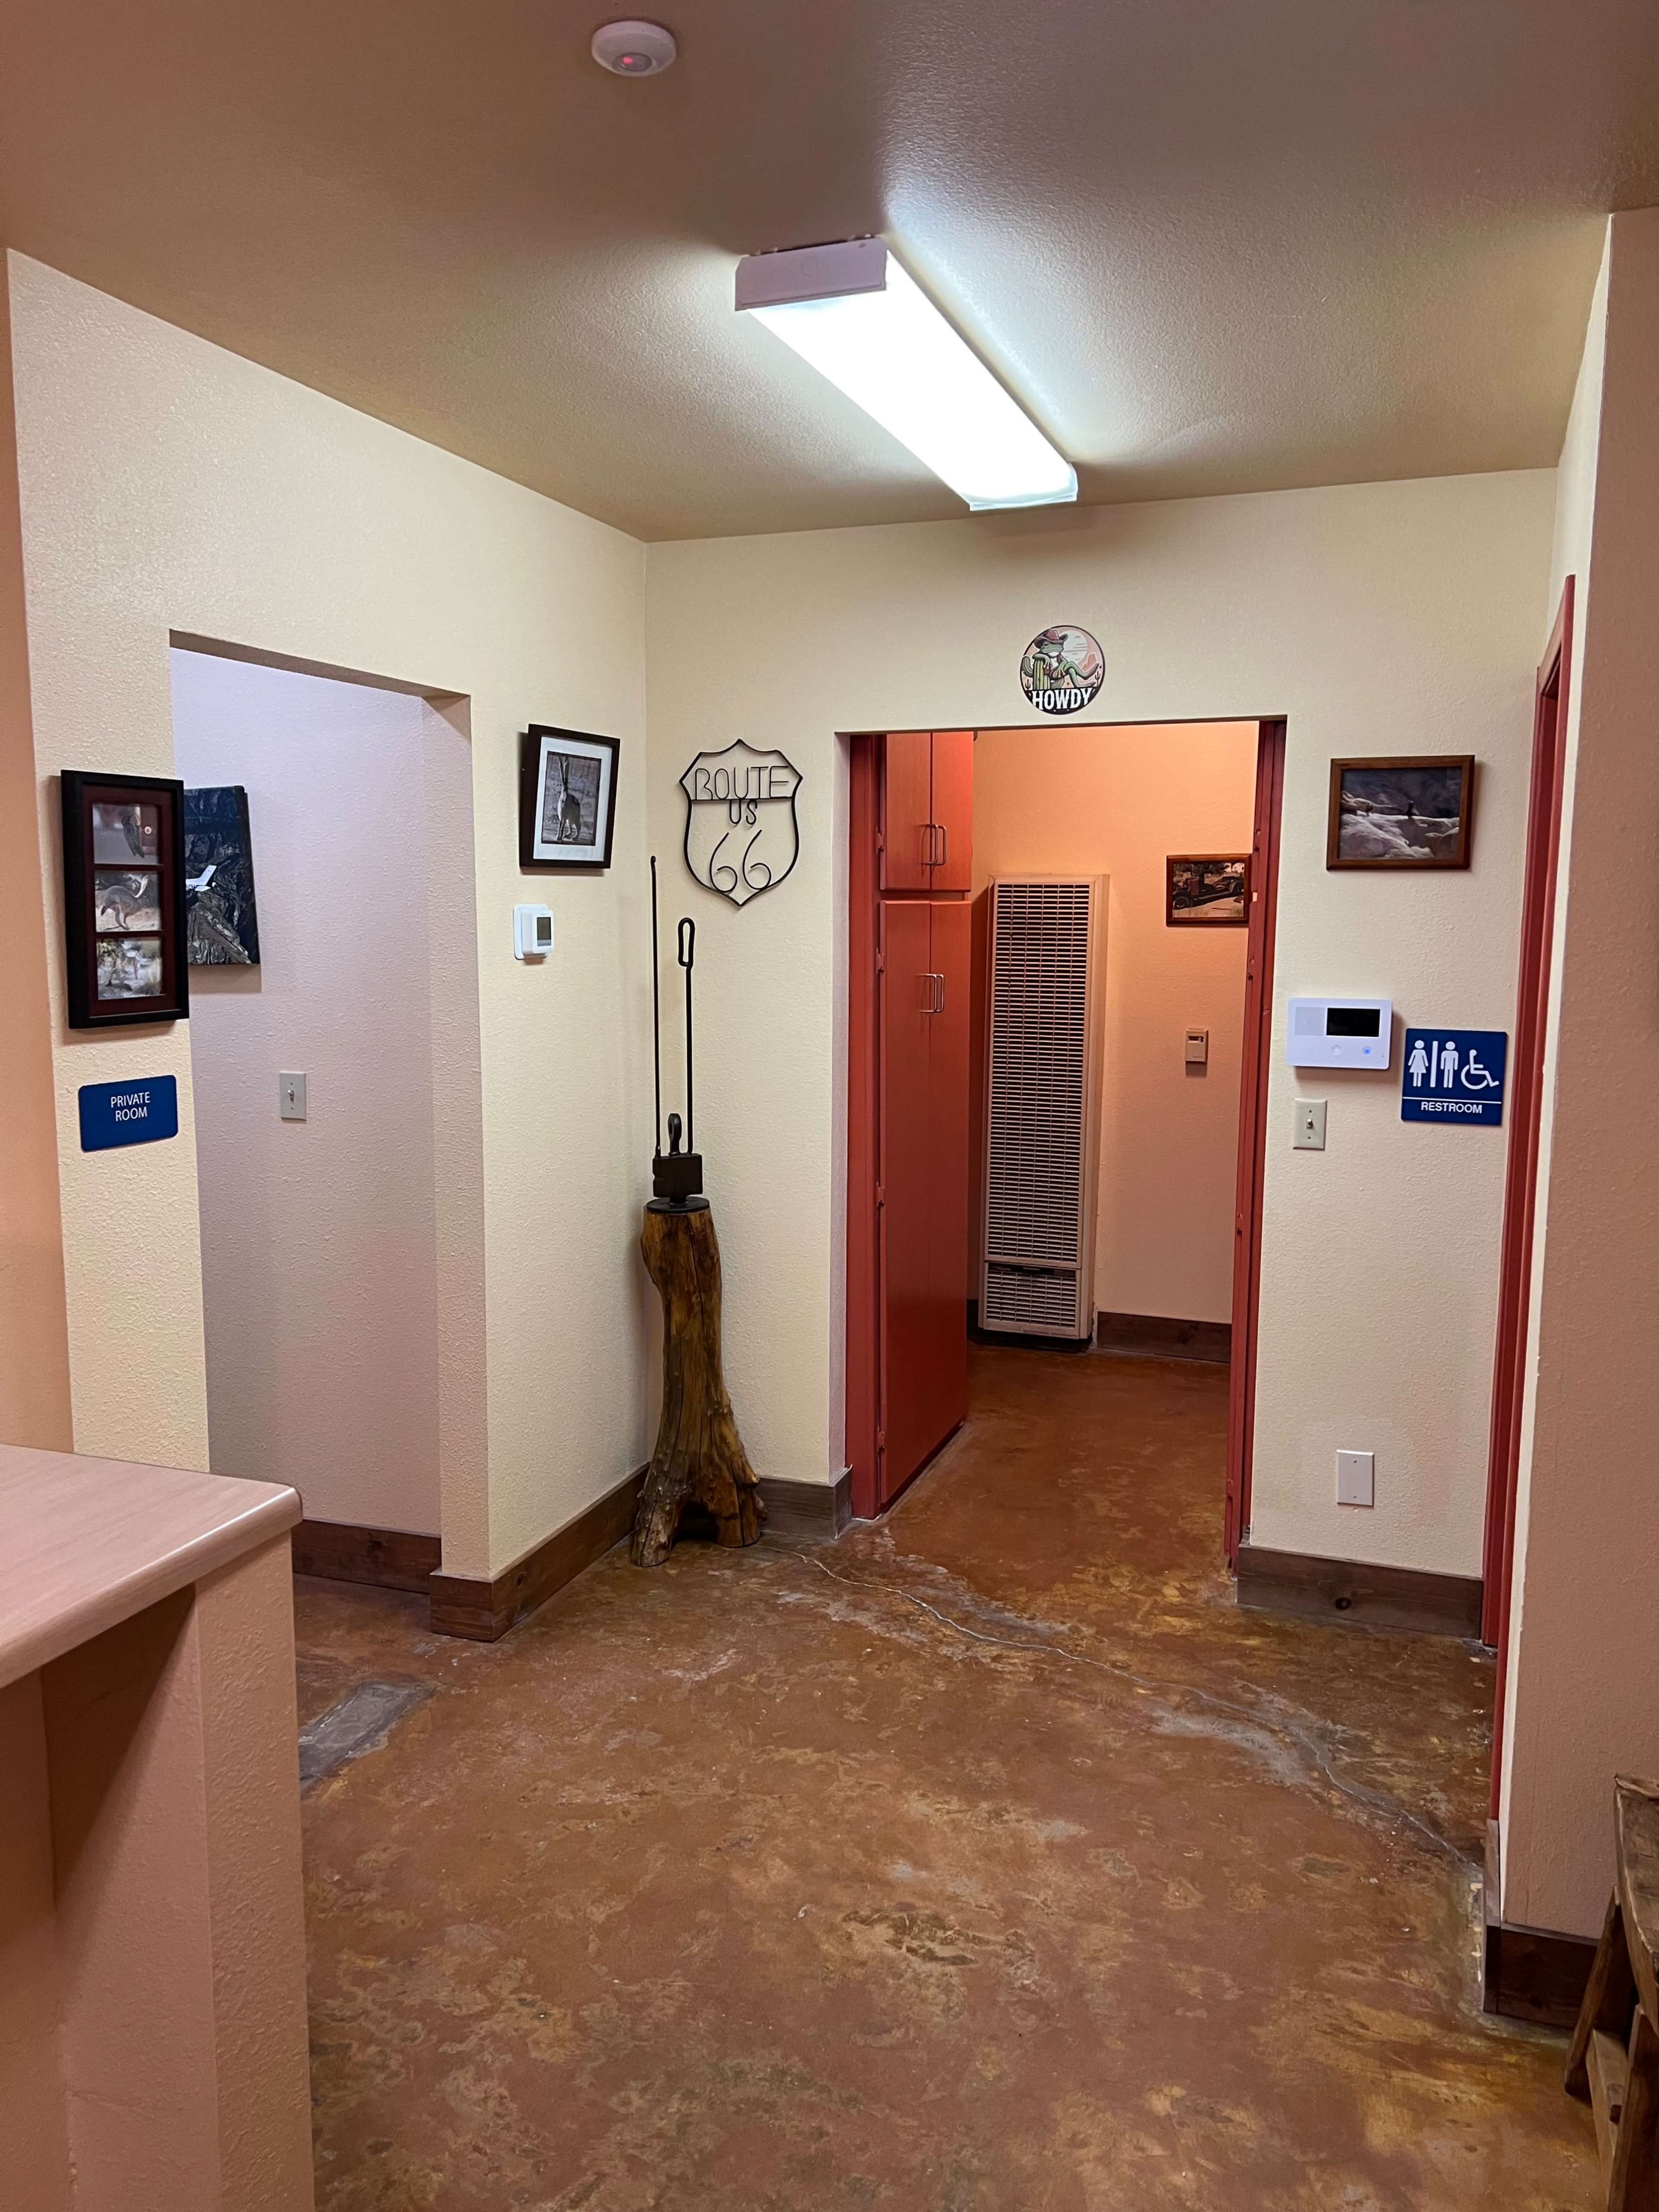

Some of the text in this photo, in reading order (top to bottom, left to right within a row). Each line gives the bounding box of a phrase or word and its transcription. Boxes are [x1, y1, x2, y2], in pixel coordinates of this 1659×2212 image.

[1032, 687, 1093, 710] HOWDY
[695, 766, 789, 800] ROUTE
[729, 799, 757, 825] US
[709, 830, 772, 893] 66
[111, 1091, 150, 1108] PRIVATE
[1421, 1102, 1482, 1113] RESTROOM
[115, 1106, 147, 1122] ROOM
